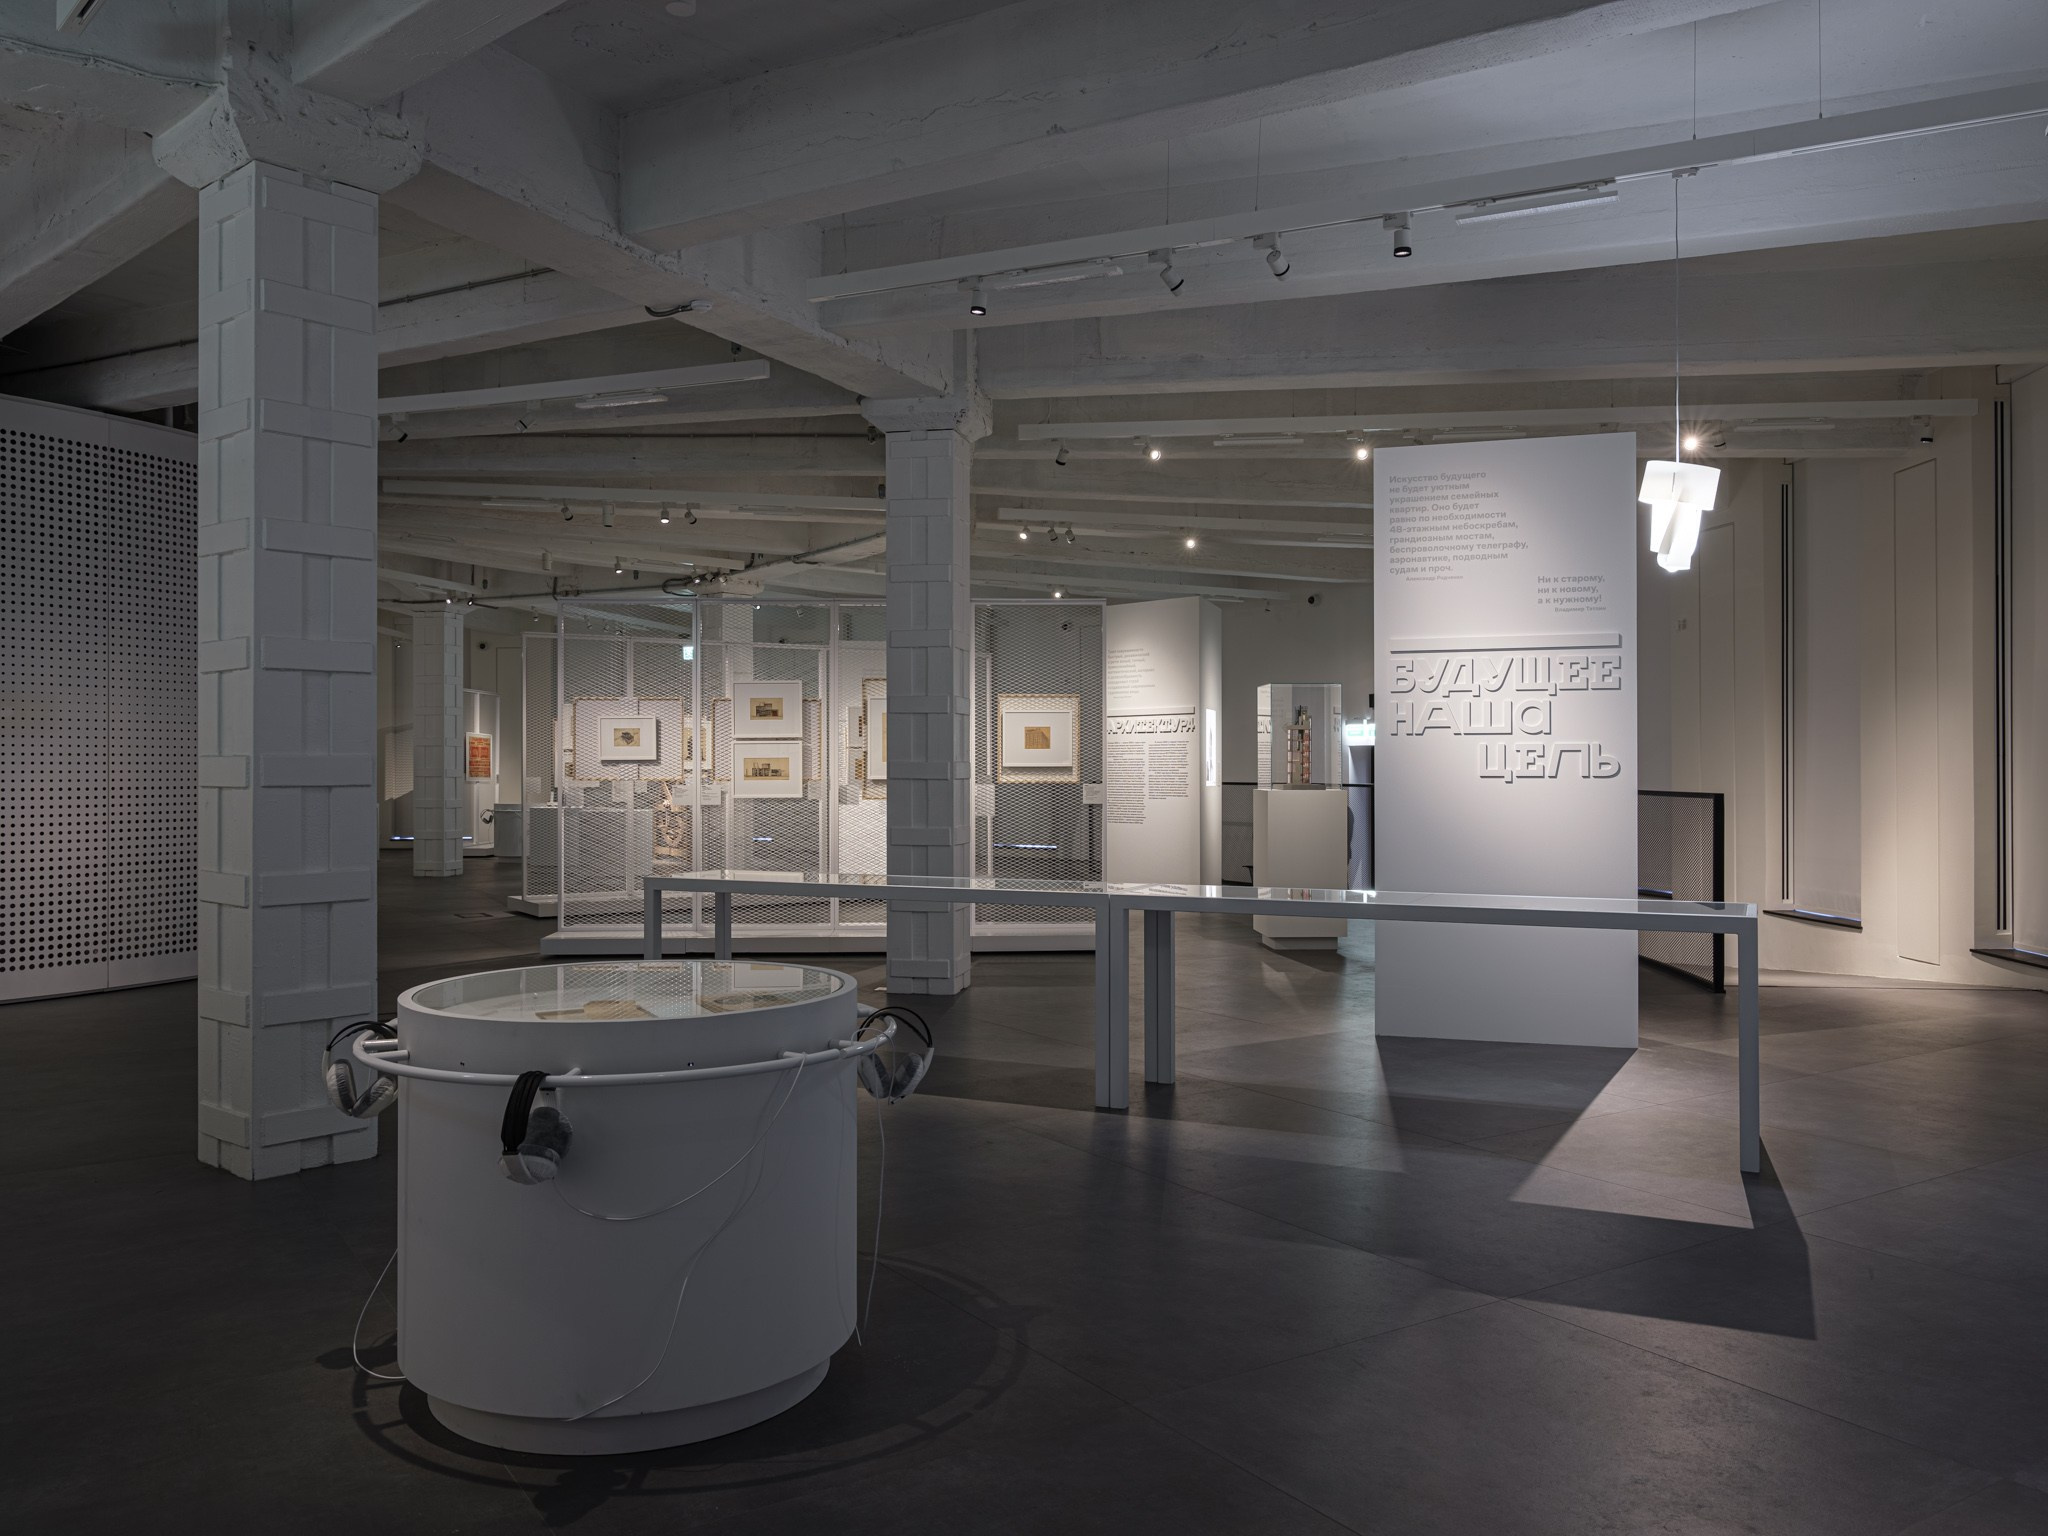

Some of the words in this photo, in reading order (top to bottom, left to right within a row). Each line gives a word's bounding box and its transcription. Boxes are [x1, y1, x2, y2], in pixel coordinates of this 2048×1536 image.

[1389, 475, 1438, 484] Искусство
[1440, 472, 1486, 481] будущего
[1402, 485, 1427, 493] будет
[1430, 484, 1469, 492] уютным
[1389, 495, 1448, 504] украшением
[1450, 491, 1499, 500] семейных
[1389, 506, 1429, 514] квартир.
[1452, 503, 1479, 511] будет
[1389, 517, 1416, 525] равно
[1432, 512, 1506, 521] необходимости
[1389, 525, 1449, 533] 48-этажным
[1452, 522, 1518, 530] небоскребам,
[1389, 536, 1453, 544] грандиозным
[1456, 533, 1494, 541] мостам,
[1389, 543, 1474, 554] беспроволочному
[1476, 540, 1528, 550] телеграфу,
[1390, 555, 1450, 564] аэронавтике,
[1453, 553, 1508, 562] подводным
[1390, 566, 1418, 574] судам
[1553, 595, 1602, 605] нужному!
[1390, 655, 1621, 697] БУДУЩЕЕ
[1479, 742, 1621, 784] ЦЕЛЬ
